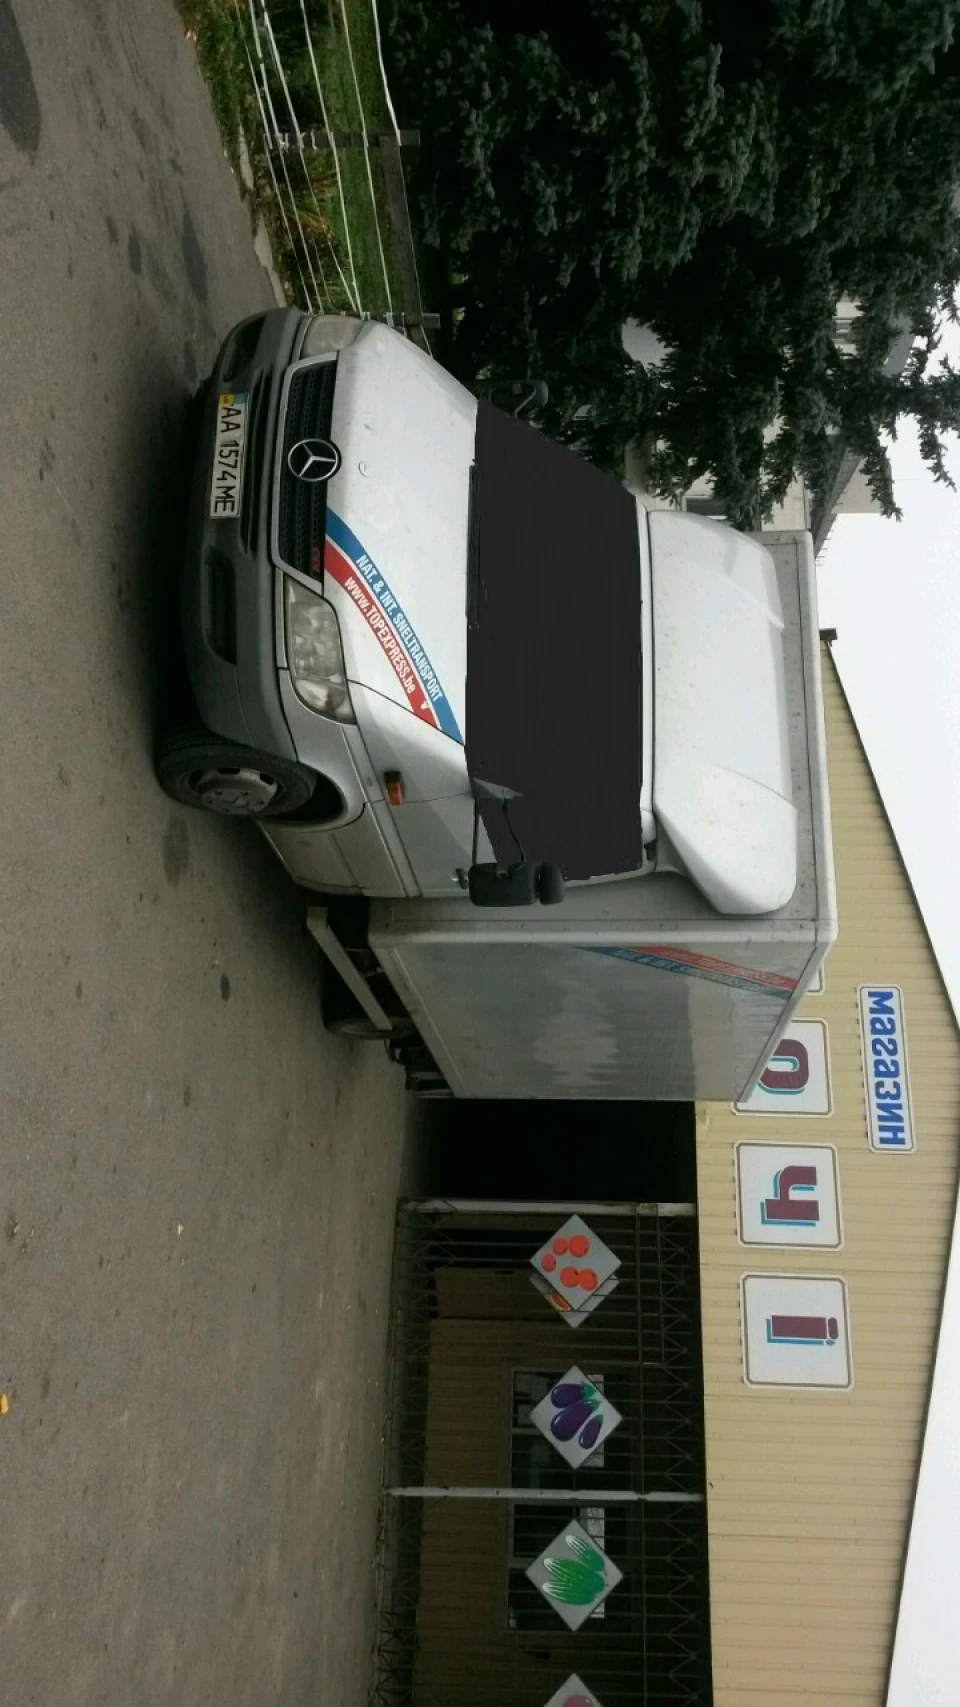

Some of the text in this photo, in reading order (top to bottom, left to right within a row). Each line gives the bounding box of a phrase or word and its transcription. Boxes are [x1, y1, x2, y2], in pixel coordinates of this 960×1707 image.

[214, 407, 241, 513] AA 1574 ME
[344, 577, 416, 693] www.TOPEXPRESS.be
[356, 555, 443, 702] NAT. & INT. SNELTRANSPORT
